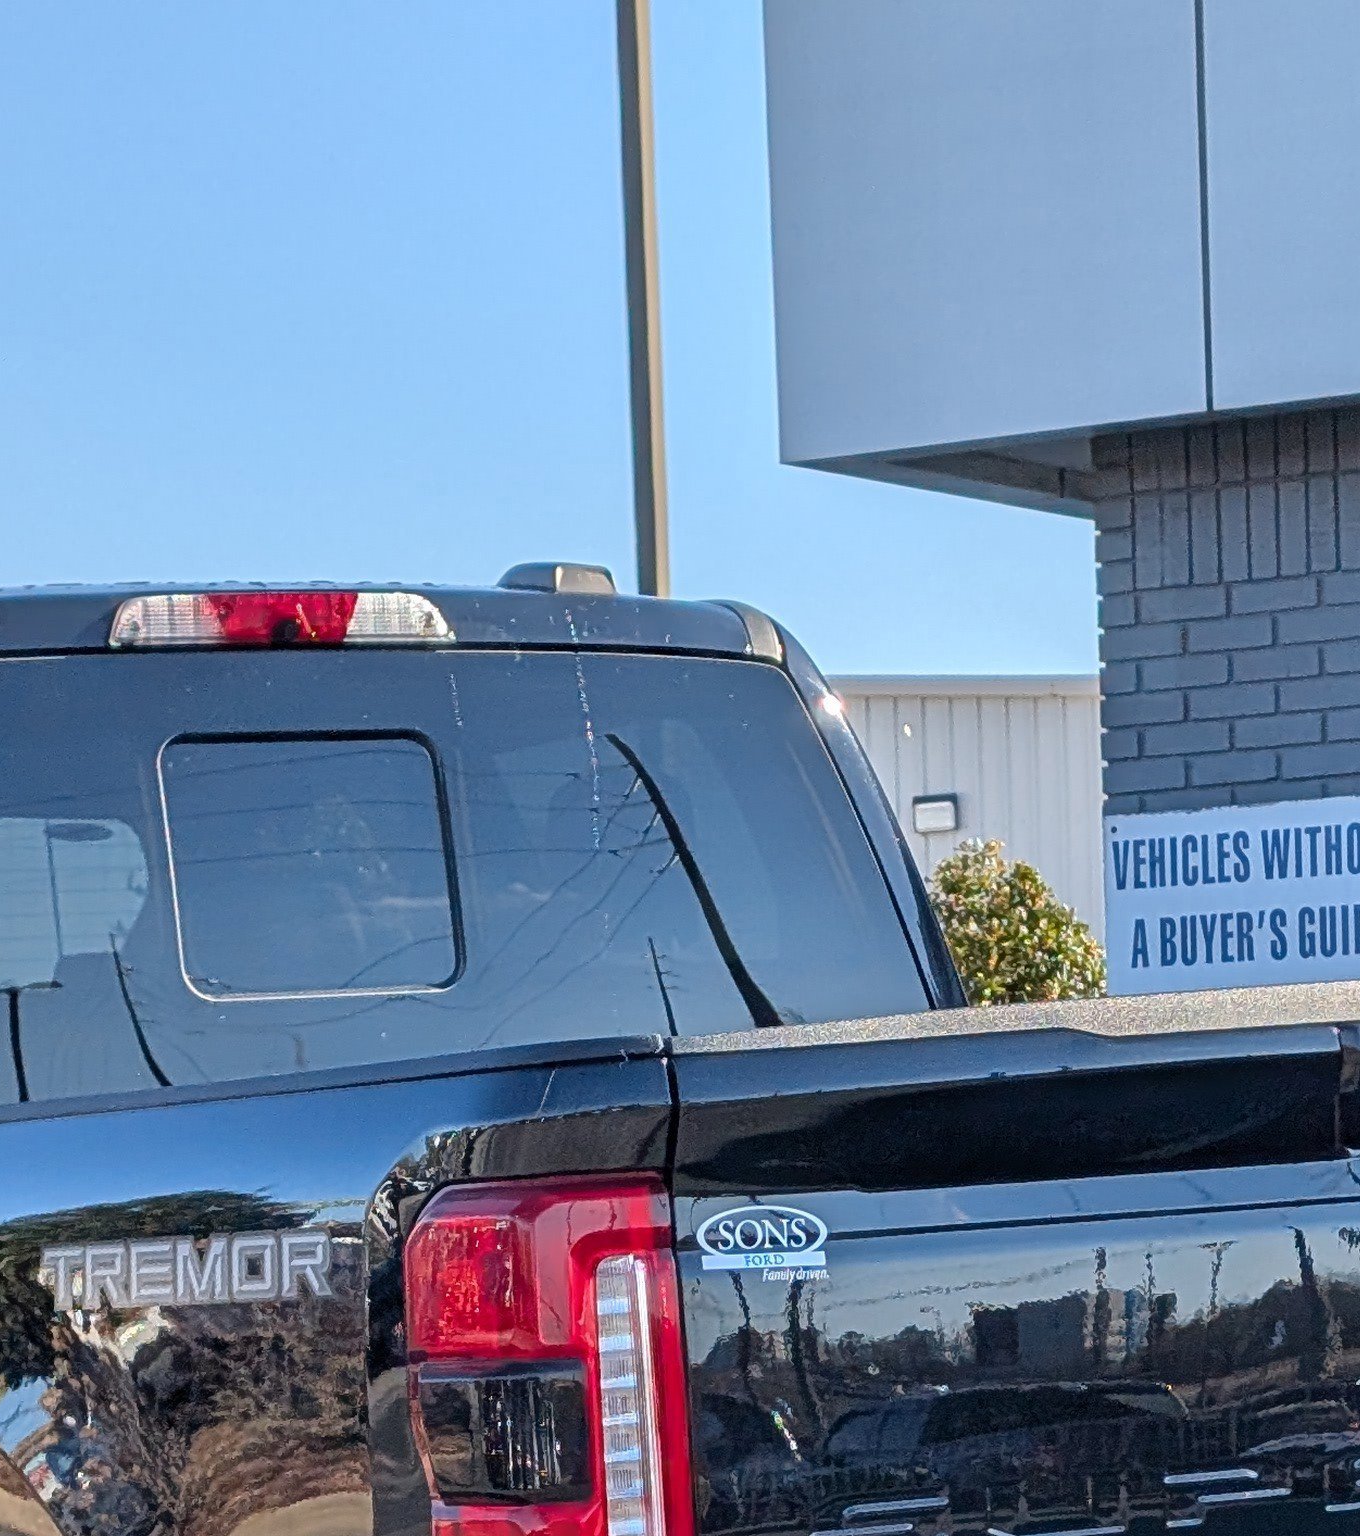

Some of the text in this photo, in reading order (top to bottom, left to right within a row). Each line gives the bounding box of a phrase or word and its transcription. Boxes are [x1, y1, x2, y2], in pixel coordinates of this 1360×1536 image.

[1112, 830, 1250, 890] VEHICLES
[1131, 918, 1149, 968] A
[1159, 908, 1288, 967] BUYER'S
[717, 1218, 807, 1250] SONS
[743, 1253, 786, 1267] FORD
[42, 1228, 335, 1311] TREMOR
